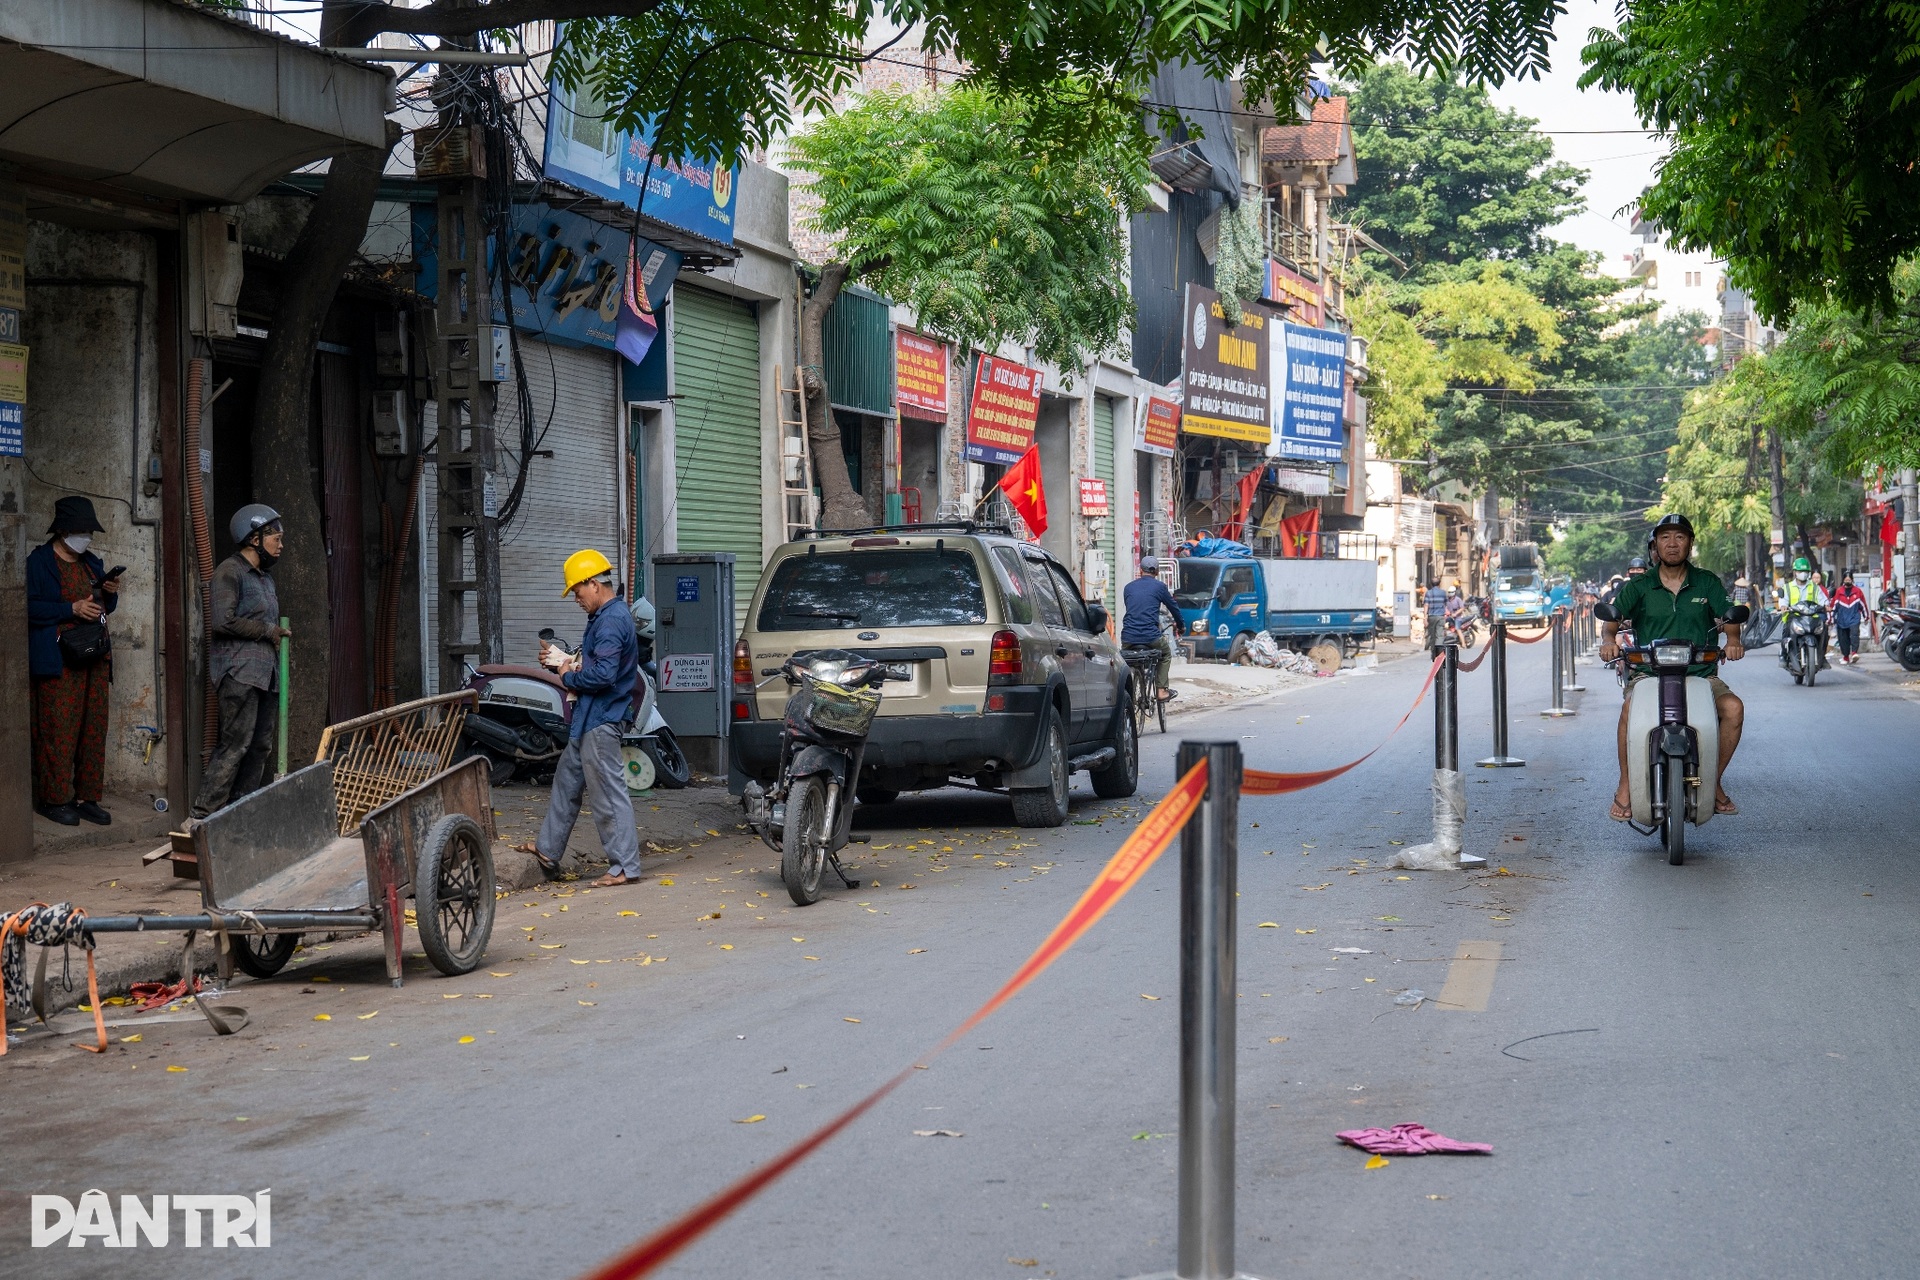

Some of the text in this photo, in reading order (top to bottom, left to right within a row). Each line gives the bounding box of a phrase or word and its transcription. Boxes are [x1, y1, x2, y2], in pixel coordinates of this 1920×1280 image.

[716, 167, 731, 197] 191
[1241, 340, 1257, 371] ANH
[1292, 359, 1303, 382] BÁN
[1304, 361, 1319, 385] BUÔN
[1322, 364, 1333, 387] BÁN
[674, 657, 695, 667] DỪNG
